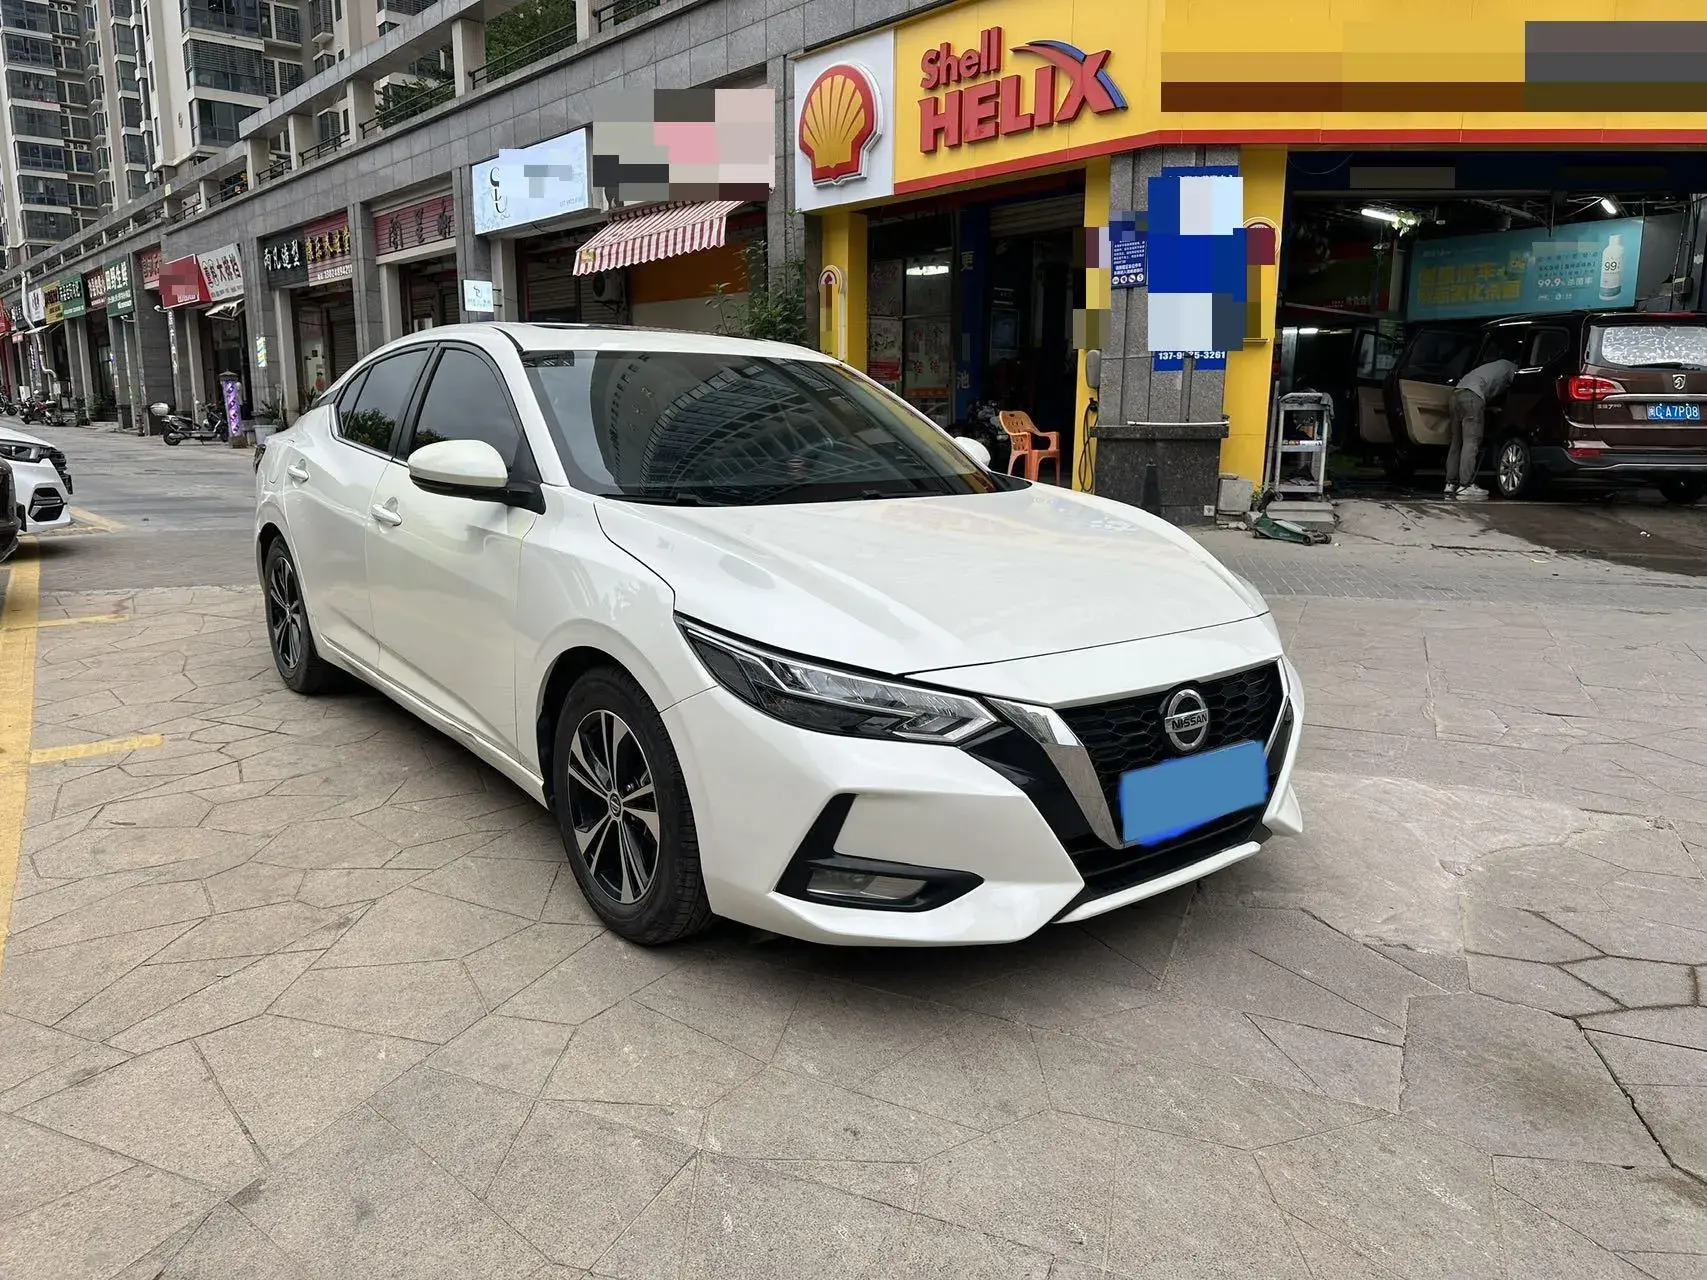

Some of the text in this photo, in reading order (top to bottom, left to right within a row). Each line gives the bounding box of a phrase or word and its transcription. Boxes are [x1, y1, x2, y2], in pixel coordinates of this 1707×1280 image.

[920, 26, 1003, 90] Shell
[918, 40, 1127, 153] HELIX
[1158, 350, 1226, 360] 137-95-3261
[1172, 713, 1208, 730] NISSAN
